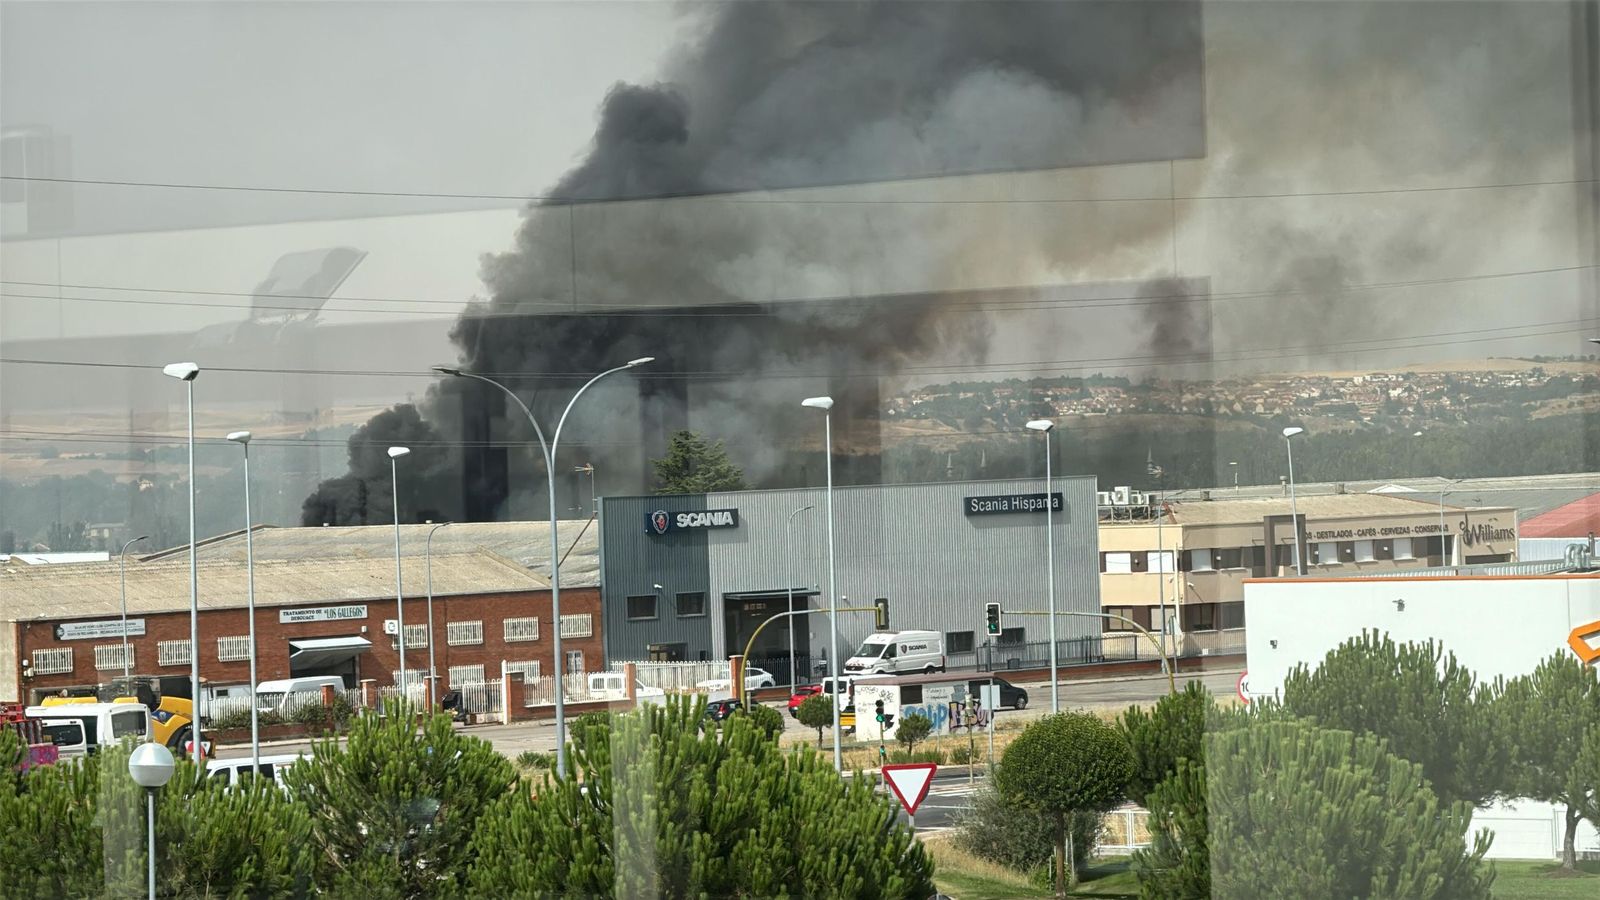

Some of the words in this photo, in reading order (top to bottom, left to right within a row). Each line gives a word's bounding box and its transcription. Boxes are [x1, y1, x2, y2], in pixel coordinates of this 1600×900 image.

[971, 497, 1008, 512] Scania
[1011, 496, 1059, 512] Hispana
[676, 511, 734, 528] SCANIA
[1316, 529, 1353, 539] DESTILADOS
[1380, 525, 1410, 535] CERVEZAS
